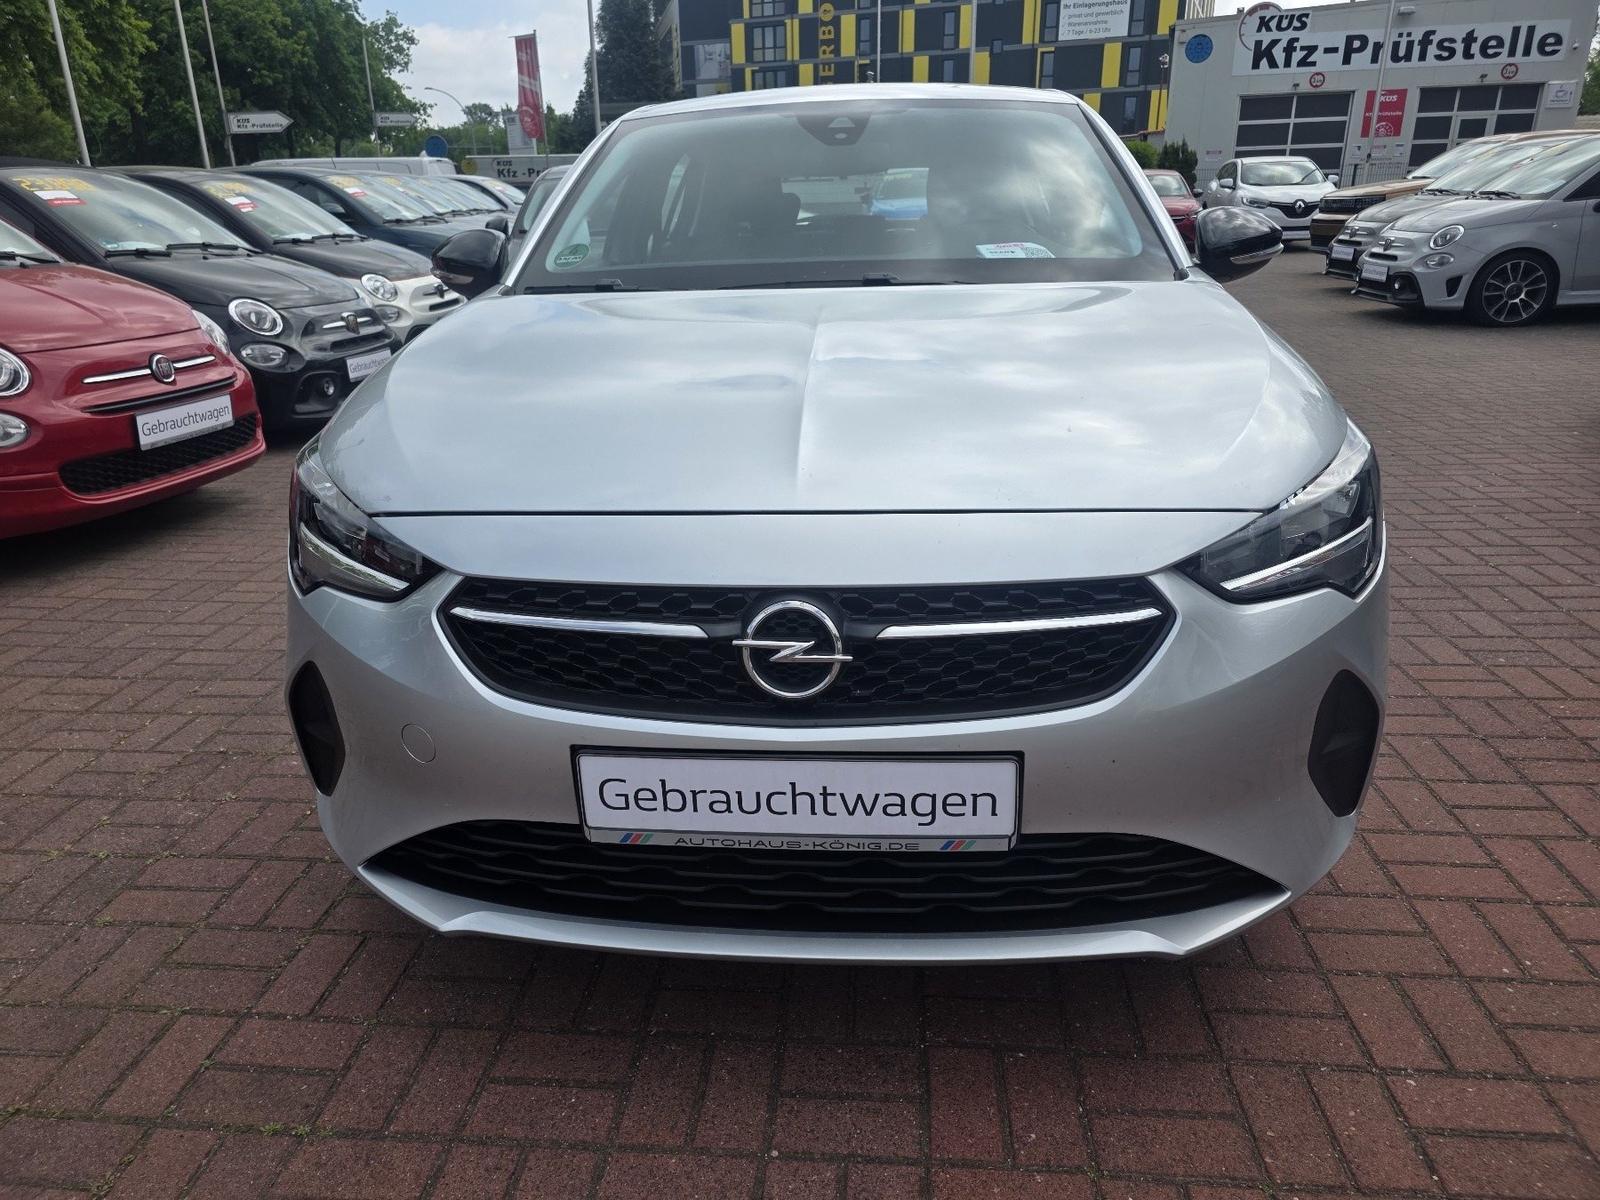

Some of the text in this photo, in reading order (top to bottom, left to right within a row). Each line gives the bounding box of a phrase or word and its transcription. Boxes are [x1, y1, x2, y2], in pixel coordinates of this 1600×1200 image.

[1256, 12, 1310, 33] KÜS
[819, 3, 835, 85] ERBO
[1251, 25, 1563, 70] Kfz-Prüfstelle
[141, 405, 230, 436] Gebrauchtwagen
[599, 778, 998, 826] Gebrauchtwagen
[674, 837, 919, 851] AUTOHAUS-KÖNIG.DE
